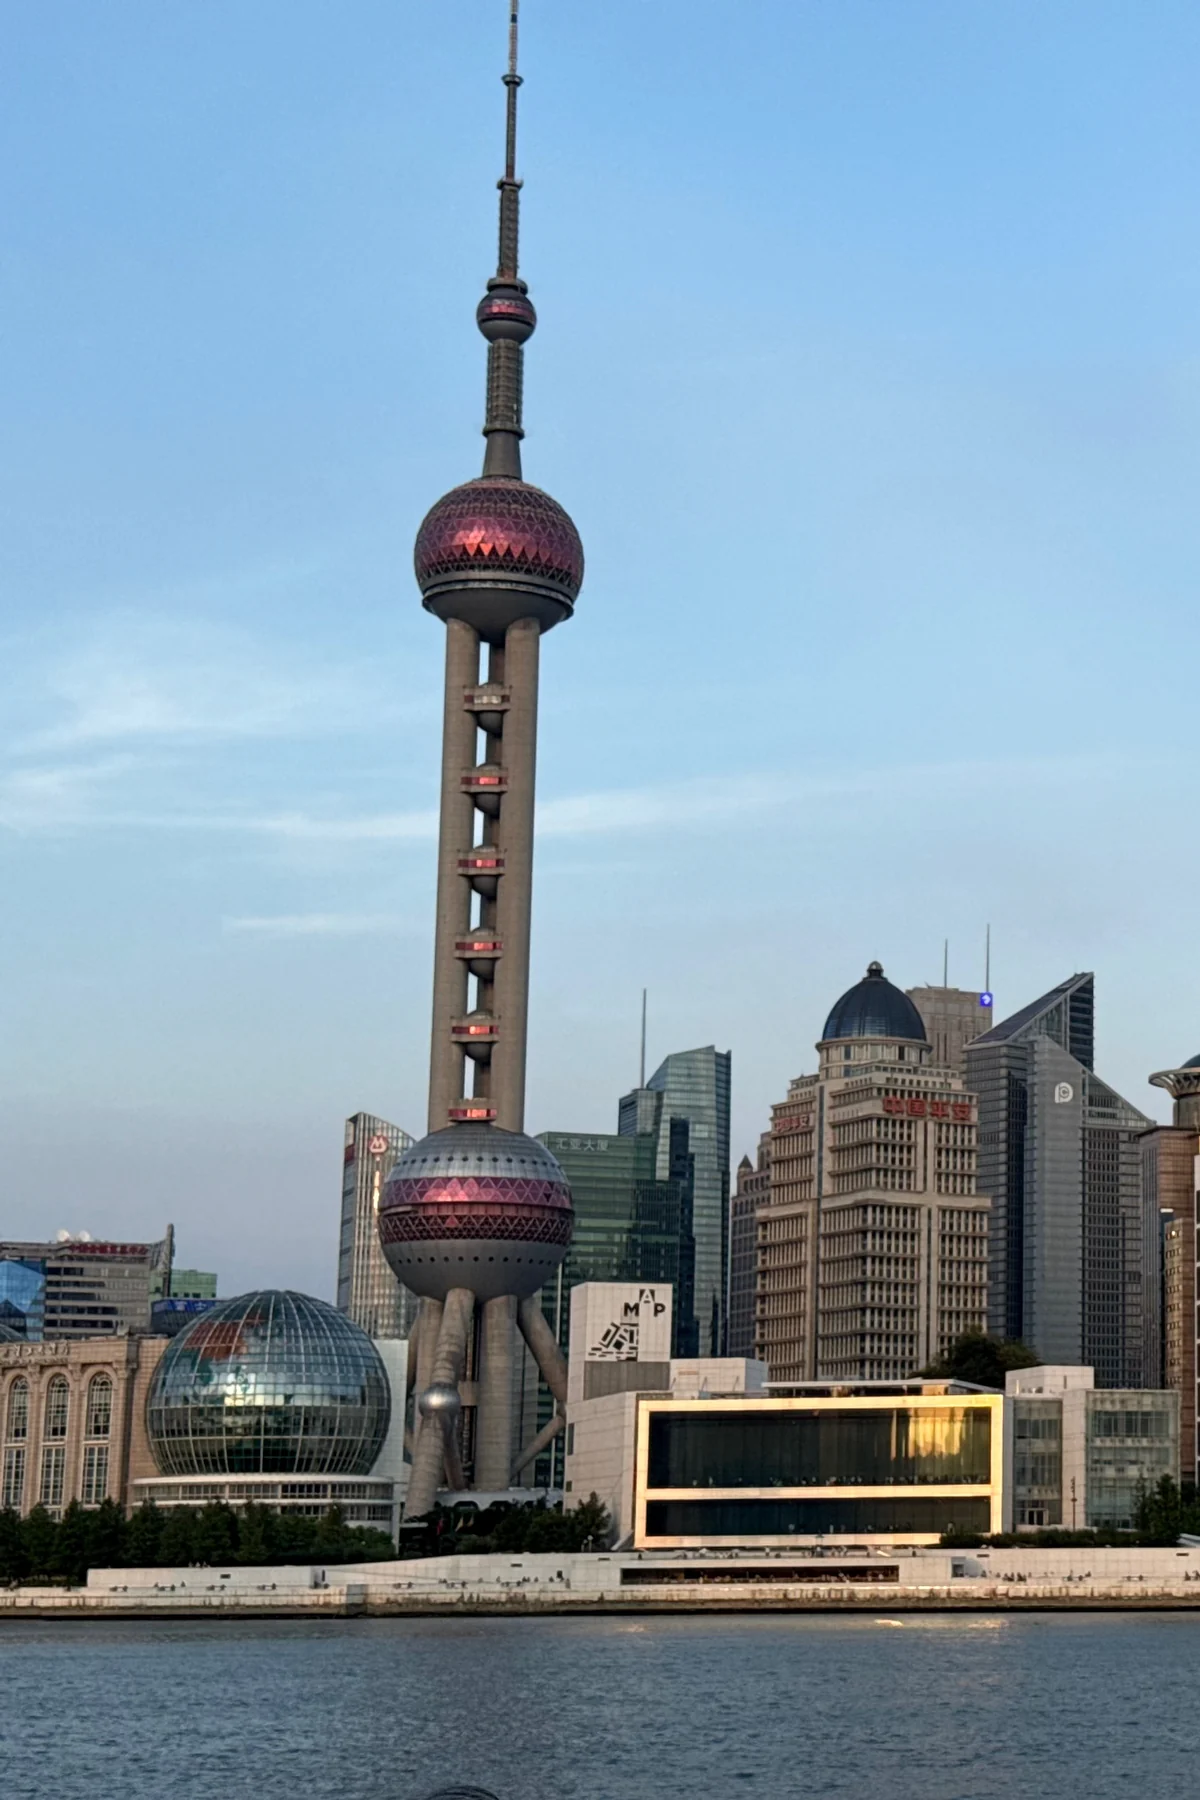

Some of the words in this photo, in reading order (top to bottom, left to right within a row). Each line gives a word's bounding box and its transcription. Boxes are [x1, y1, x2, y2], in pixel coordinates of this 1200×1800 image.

[882, 1096, 971, 1121] 中国平安
[556, 1138, 609, 1152] 汇亚大厦
[624, 1289, 666, 1318] MAP
